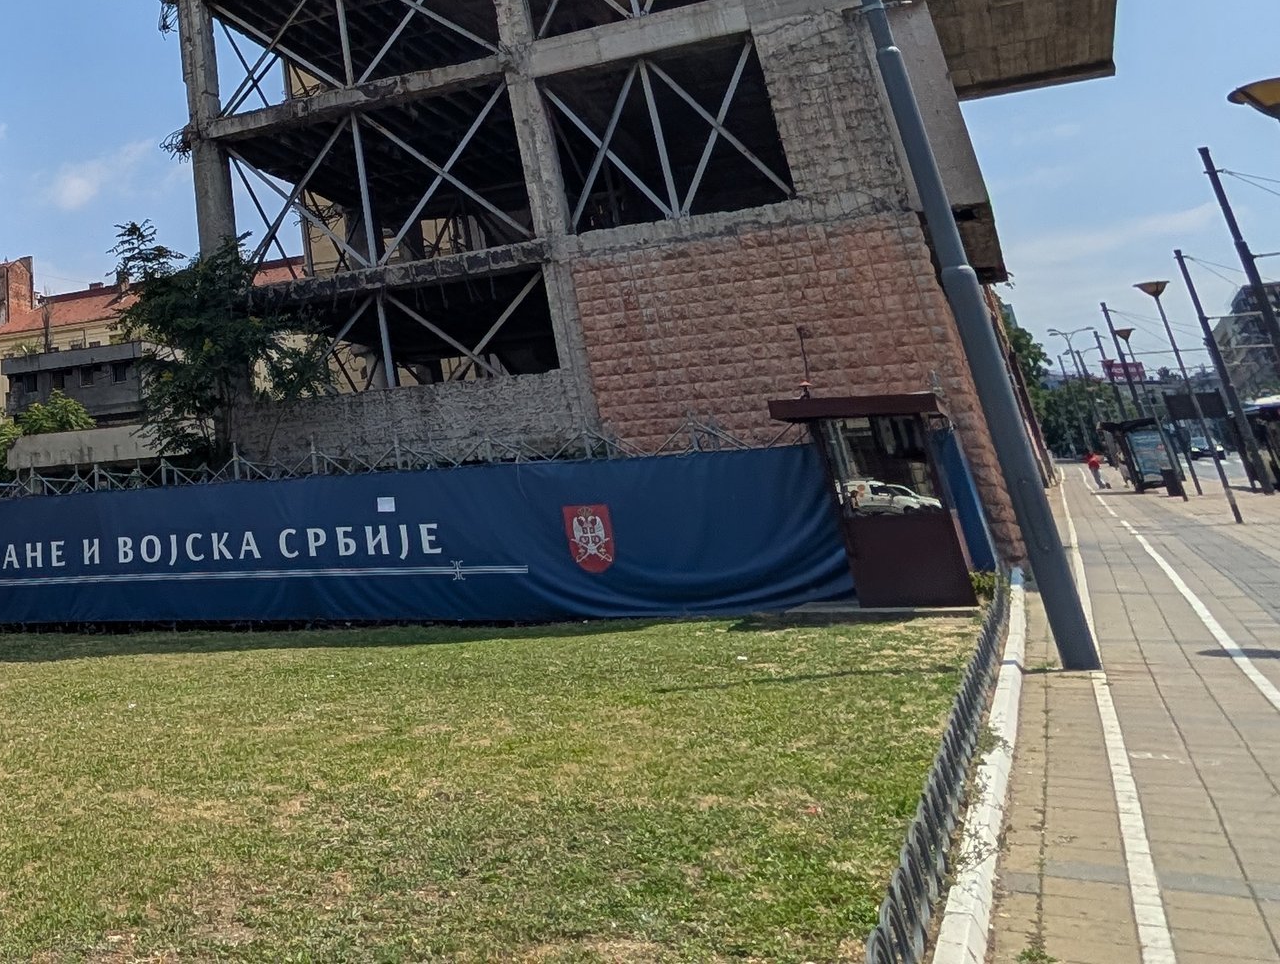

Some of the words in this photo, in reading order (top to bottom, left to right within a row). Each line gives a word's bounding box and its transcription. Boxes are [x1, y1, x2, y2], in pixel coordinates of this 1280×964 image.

[82, 538, 100, 565] И
[117, 531, 262, 566] ВОЈСКА
[279, 523, 443, 559] СРБИЈЕ
